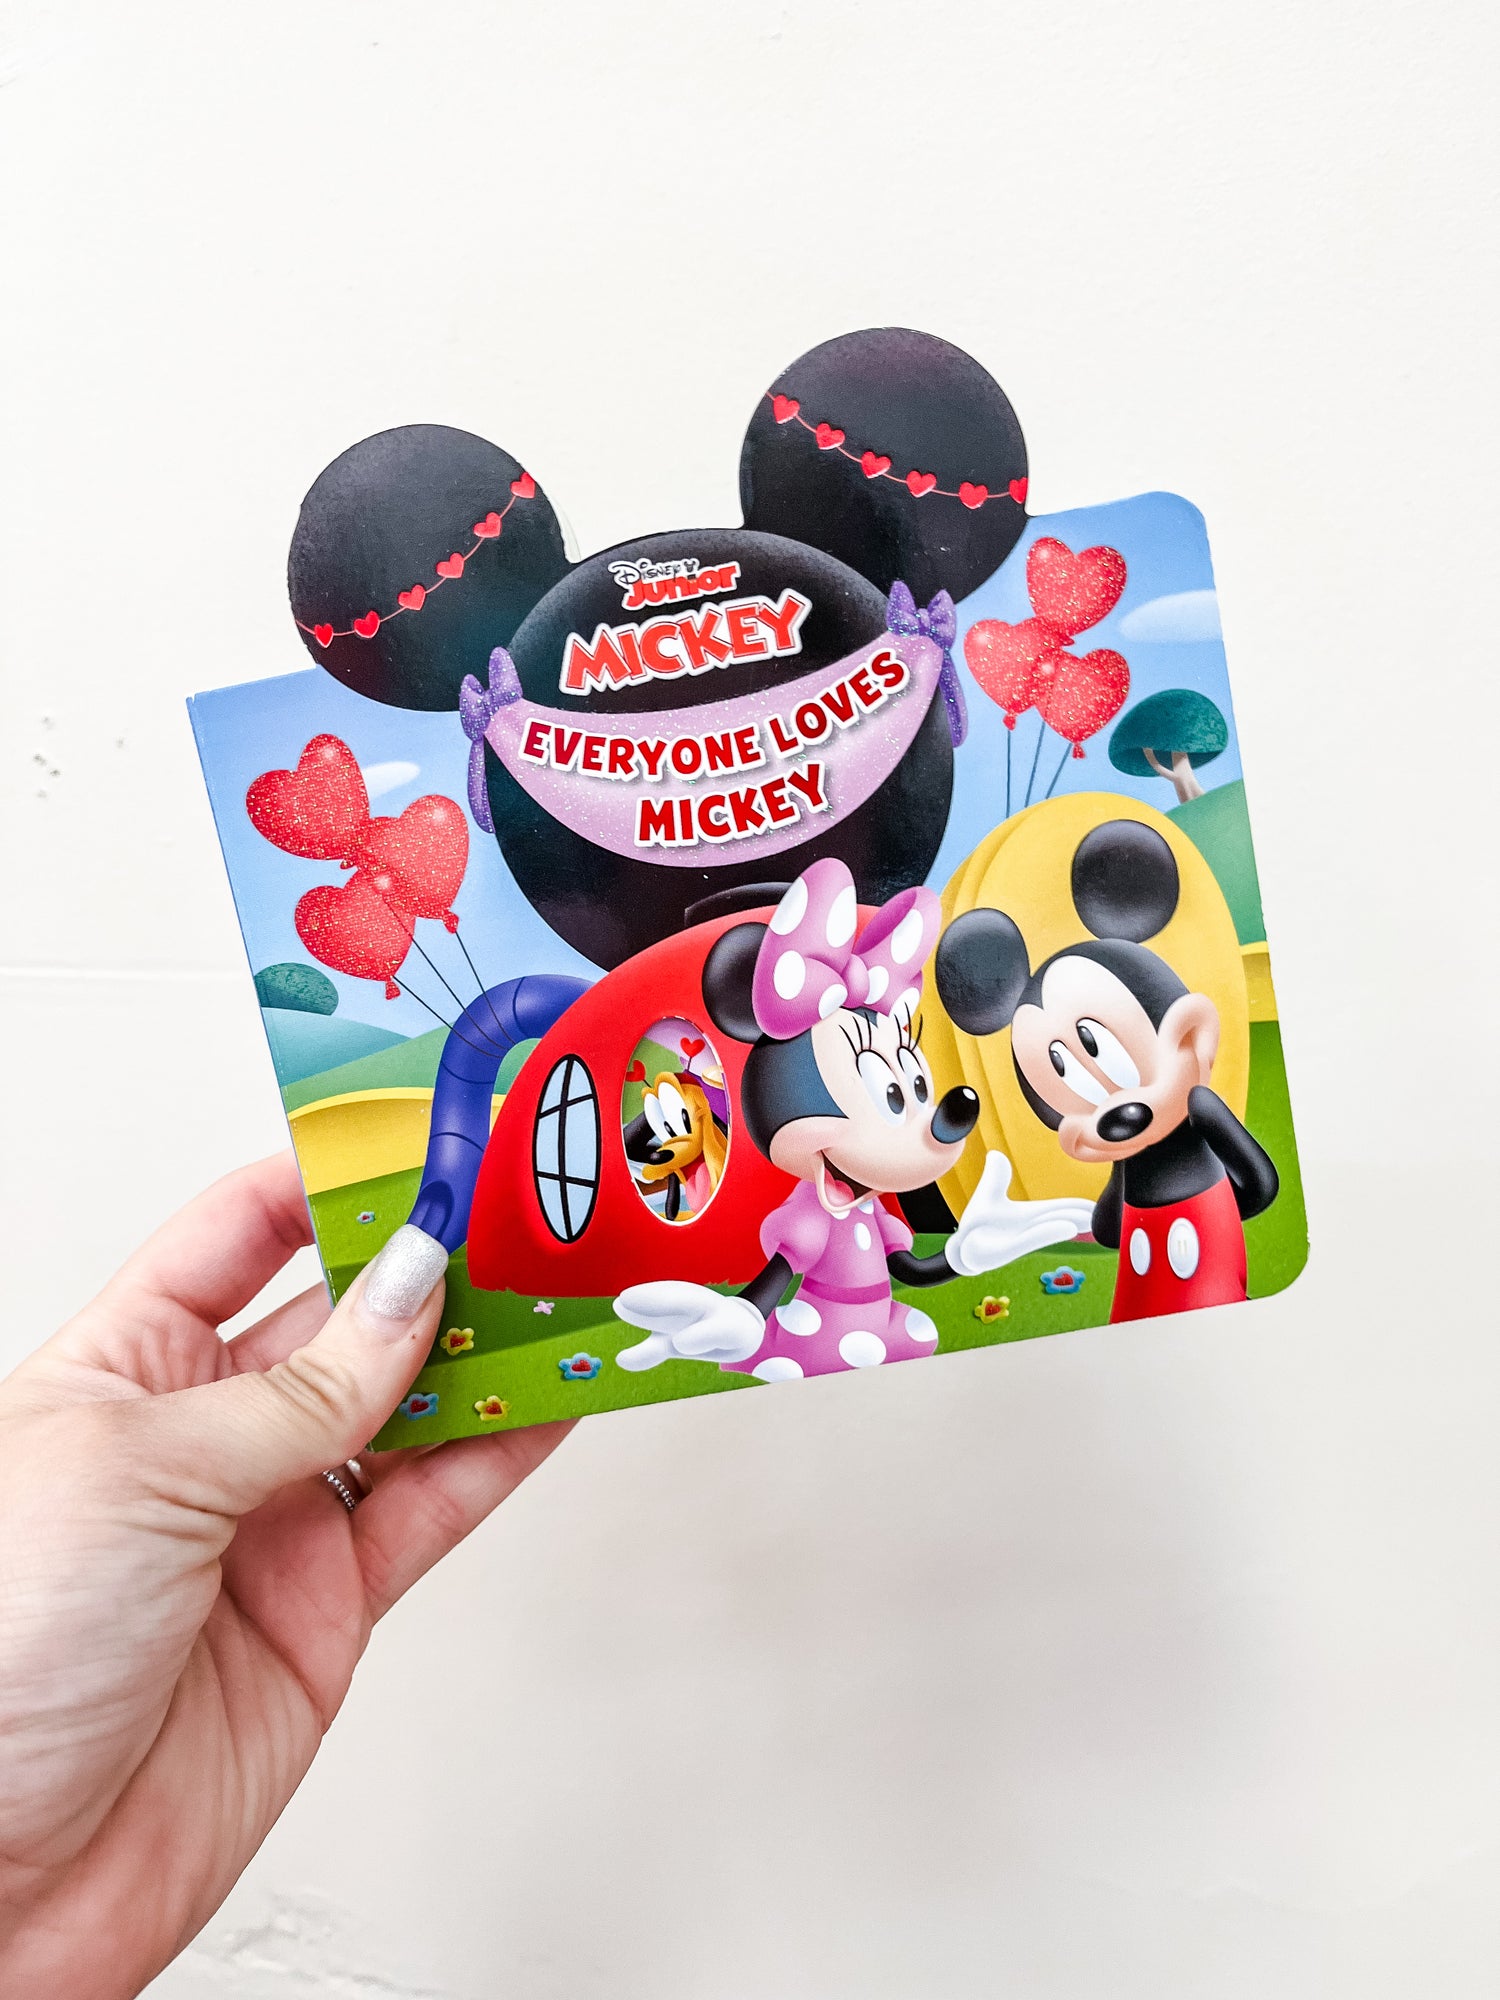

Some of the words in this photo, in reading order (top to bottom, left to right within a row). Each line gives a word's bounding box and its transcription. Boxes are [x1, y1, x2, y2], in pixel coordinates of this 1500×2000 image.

[626, 565, 737, 608] Junior
[565, 595, 806, 690] MICKEY
[524, 721, 761, 776] EVERYONE
[769, 651, 905, 753] LOVES
[638, 763, 826, 842] MICKEY
